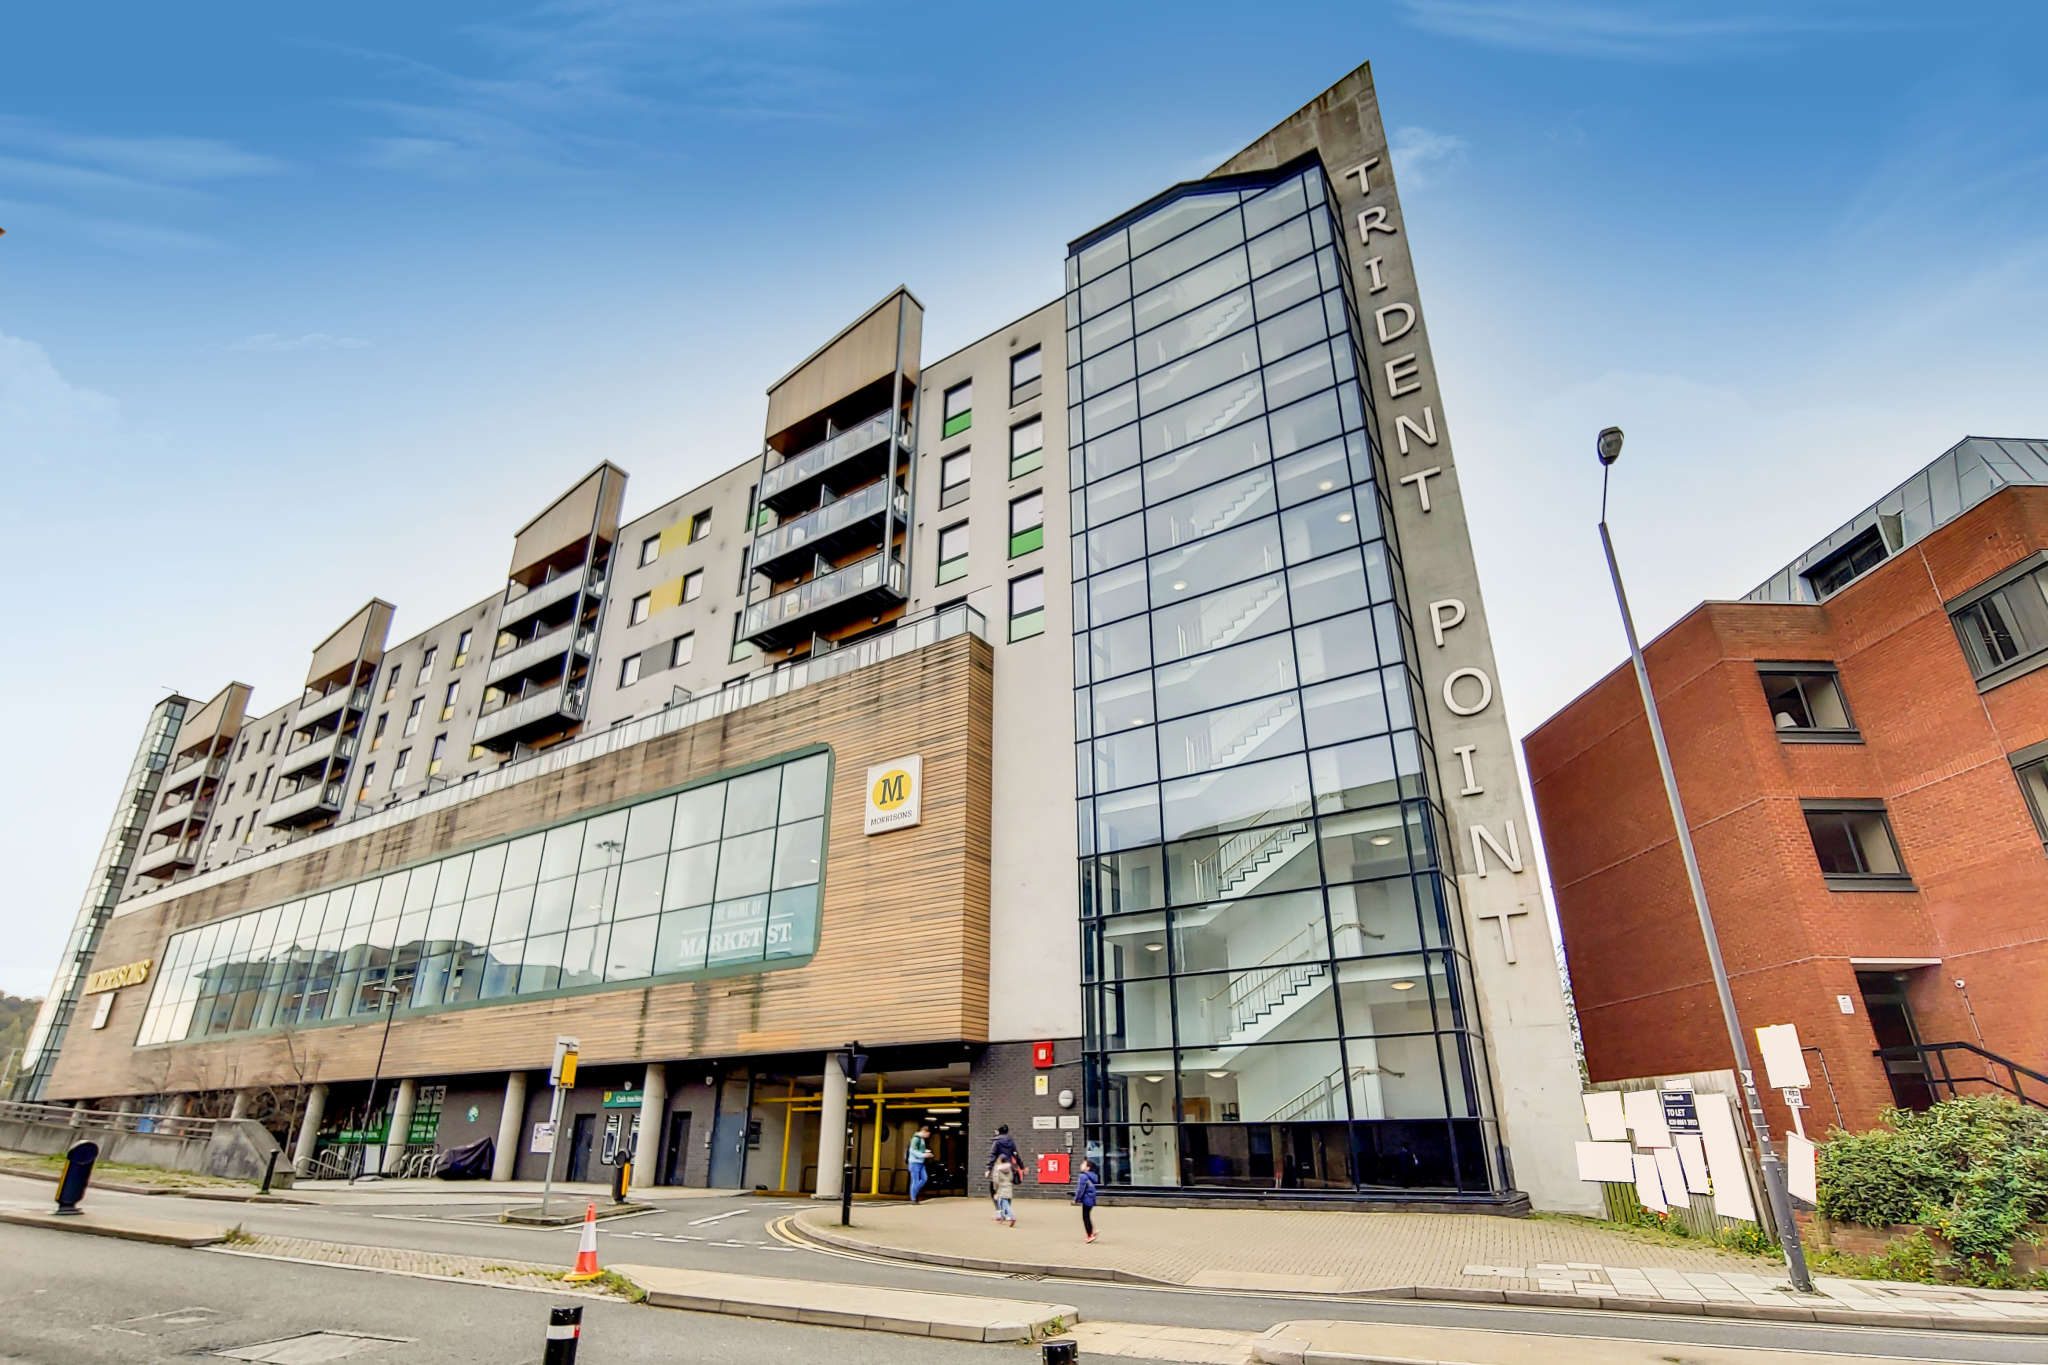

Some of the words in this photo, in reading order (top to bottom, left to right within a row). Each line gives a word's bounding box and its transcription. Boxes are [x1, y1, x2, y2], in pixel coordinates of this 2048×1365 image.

[1345, 156, 1441, 512] TRIDENT
[1429, 598, 1528, 964] POINT
[880, 775, 904, 805] M
[870, 809, 912, 826] MORRISONS
[680, 927, 764, 957] MARKET
[1675, 1108, 1685, 1117] LET
